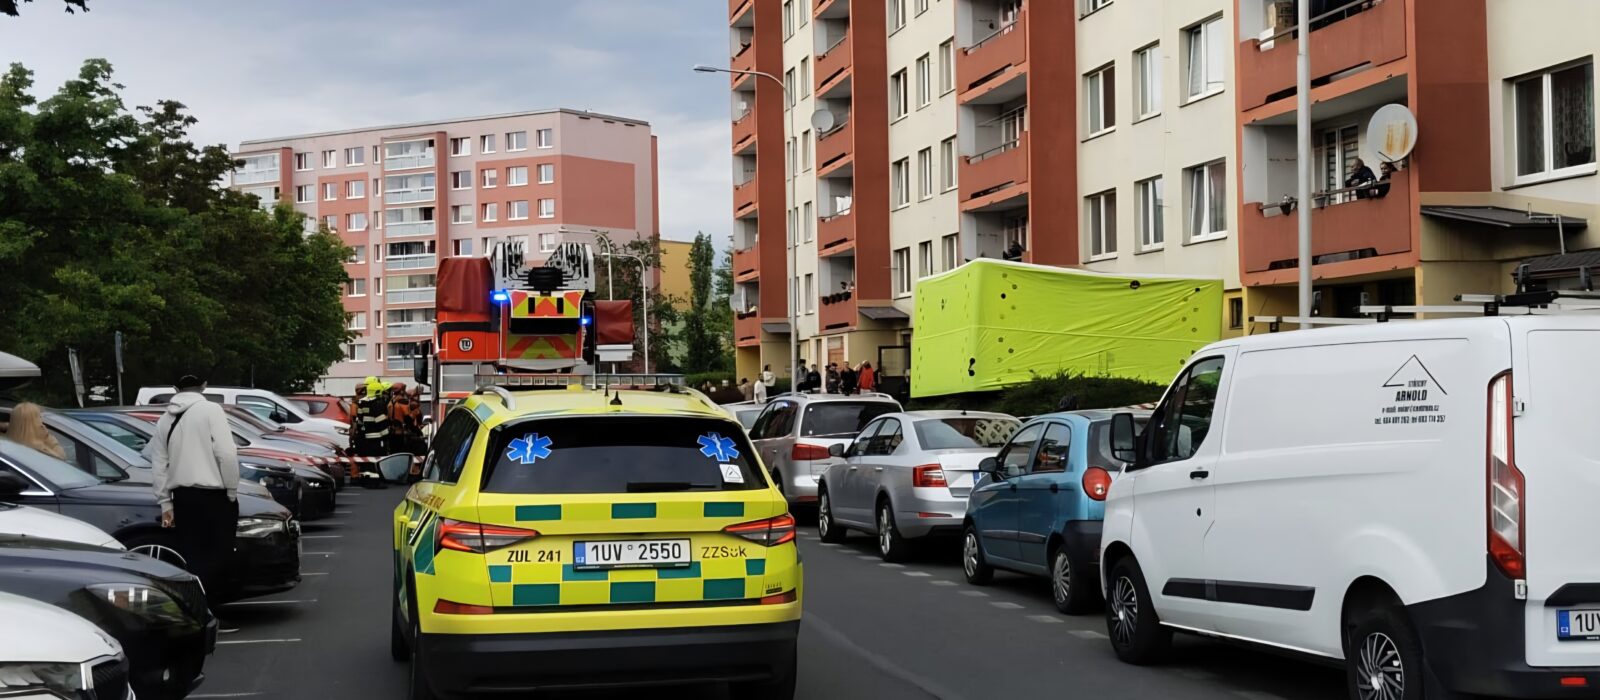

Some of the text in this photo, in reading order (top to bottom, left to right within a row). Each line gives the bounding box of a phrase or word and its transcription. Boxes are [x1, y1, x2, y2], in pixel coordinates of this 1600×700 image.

[1396, 390, 1427, 402] ARNOLD
[507, 550, 561, 562] ZUL 241
[591, 543, 681, 561] 1UV 2550
